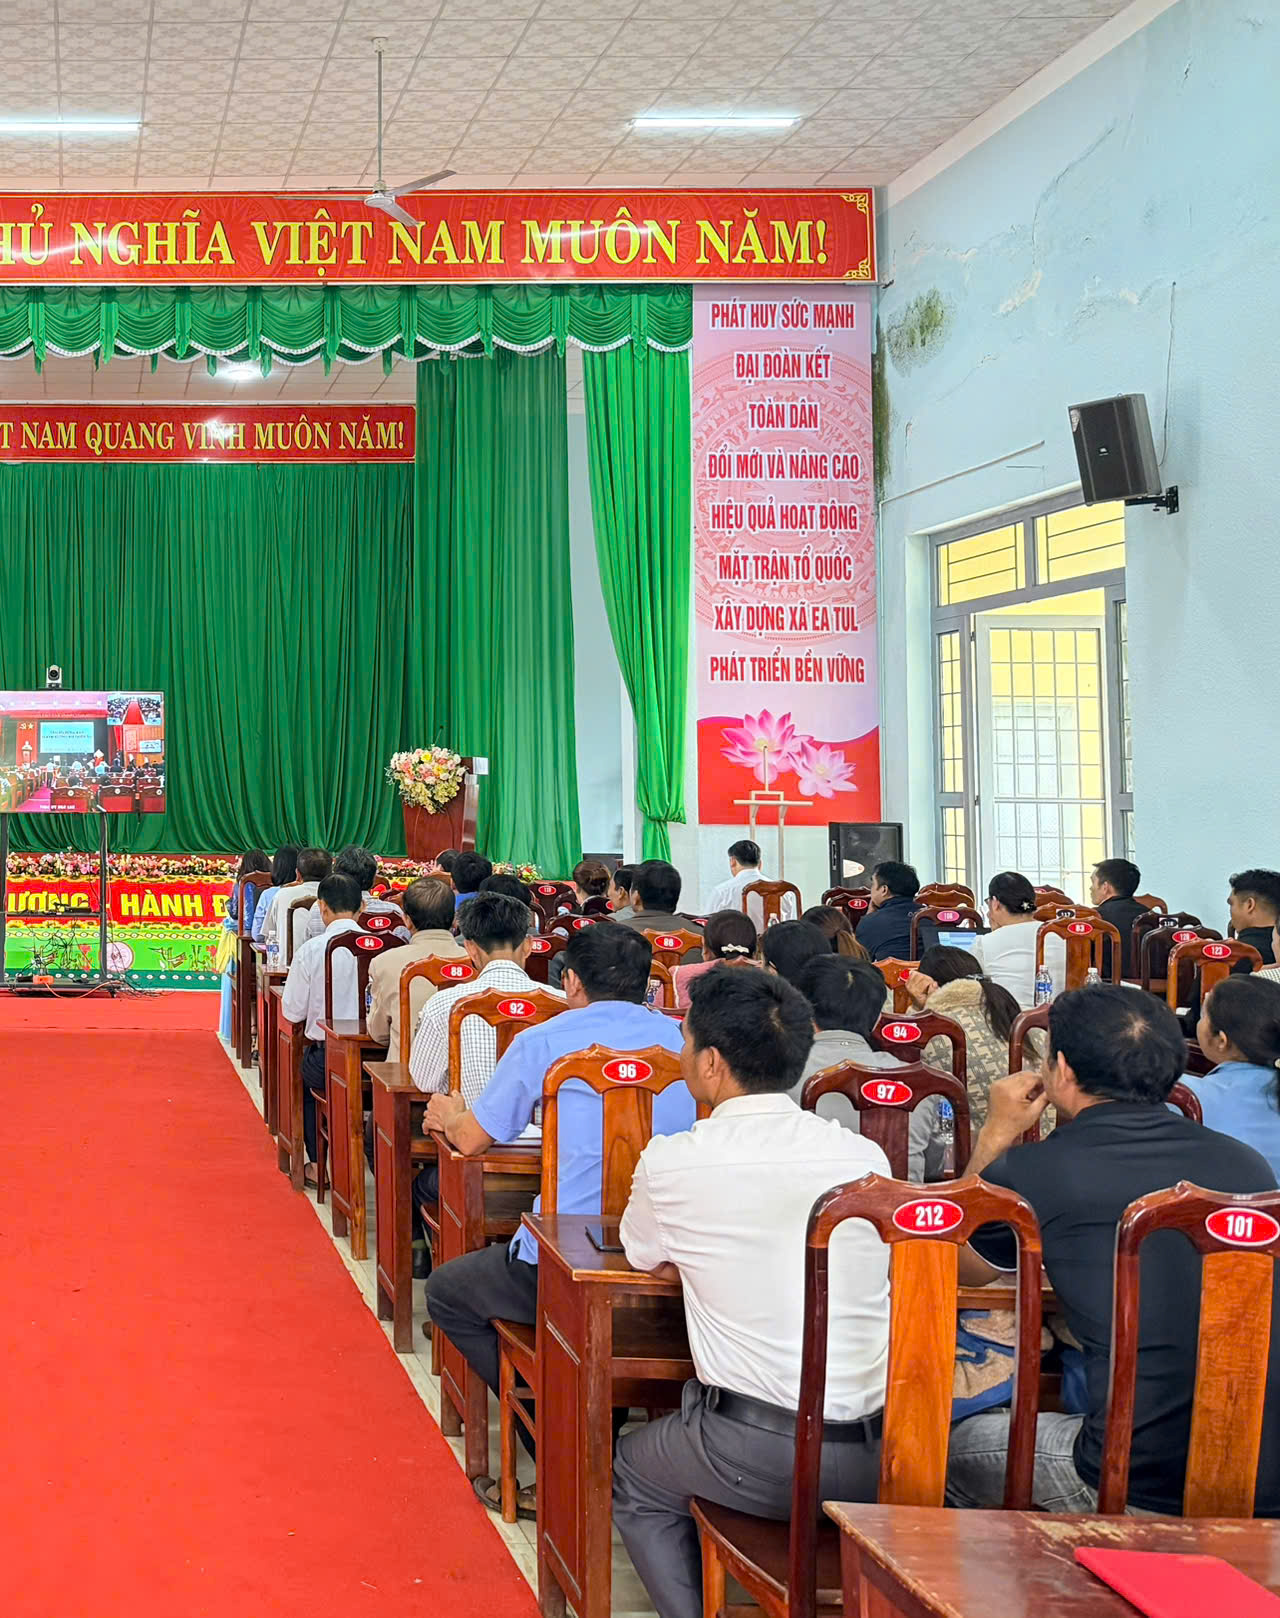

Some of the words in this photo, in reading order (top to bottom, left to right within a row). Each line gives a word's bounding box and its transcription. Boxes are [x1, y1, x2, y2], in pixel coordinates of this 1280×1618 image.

[70, 210, 235, 265] NGHĨA
[250, 207, 373, 276] VIỆT
[387, 221, 505, 264] NAM
[519, 207, 680, 264] MUÔN
[694, 207, 828, 264] NĂM!
[711, 298, 746, 328] PHÁT
[750, 304, 777, 328] HUY
[782, 299, 809, 328] SỨC
[813, 304, 855, 334] MẠNH
[736, 353, 759, 384] ĐẠI
[763, 349, 801, 378] ĐOÀN
[805, 346, 831, 378] KẾT
[749, 398, 785, 428] TOÀN
[789, 399, 818, 428] DÂN
[22, 423, 77, 449] NAM
[85, 422, 175, 456] QUANG
[183, 423, 246, 450] VINH
[254, 414, 331, 450] MUÔN
[339, 414, 405, 449] NĂM!
[708, 444, 731, 479] ĐỔI
[736, 449, 763, 479] MỚI
[767, 449, 785, 479] VÀ
[789, 449, 828, 479] NÂNG
[832, 455, 859, 480] CAO
[711, 499, 743, 534] HIỆU
[748, 496, 776, 532] QUẢ
[780, 505, 815, 535] HOẠT
[819, 500, 858, 535] ĐỘNG
[719, 550, 749, 585] MẶT
[752, 550, 790, 585] TRẬN
[793, 545, 811, 580] TỔ
[815, 547, 852, 583] QUỐC
[714, 600, 742, 630] XÂY
[746, 603, 784, 636] DỰNG
[789, 601, 808, 631] XÃ
[812, 607, 830, 631] EA
[833, 607, 858, 631] TUL
[710, 652, 746, 681] PHÁT
[750, 647, 790, 681] TRIỂN
[795, 649, 822, 682] BỀN
[826, 653, 864, 683] VỮNG
[120, 888, 204, 917] HÀNH
[1211, 945, 1223, 956] 123
[451, 966, 463, 977] 88
[509, 1002, 524, 1014] 92
[893, 1026, 908, 1038] 94
[618, 1064, 637, 1078] 96
[877, 1086, 895, 1099] 97
[914, 1203, 945, 1226] 212
[1225, 1215, 1254, 1237] 101
